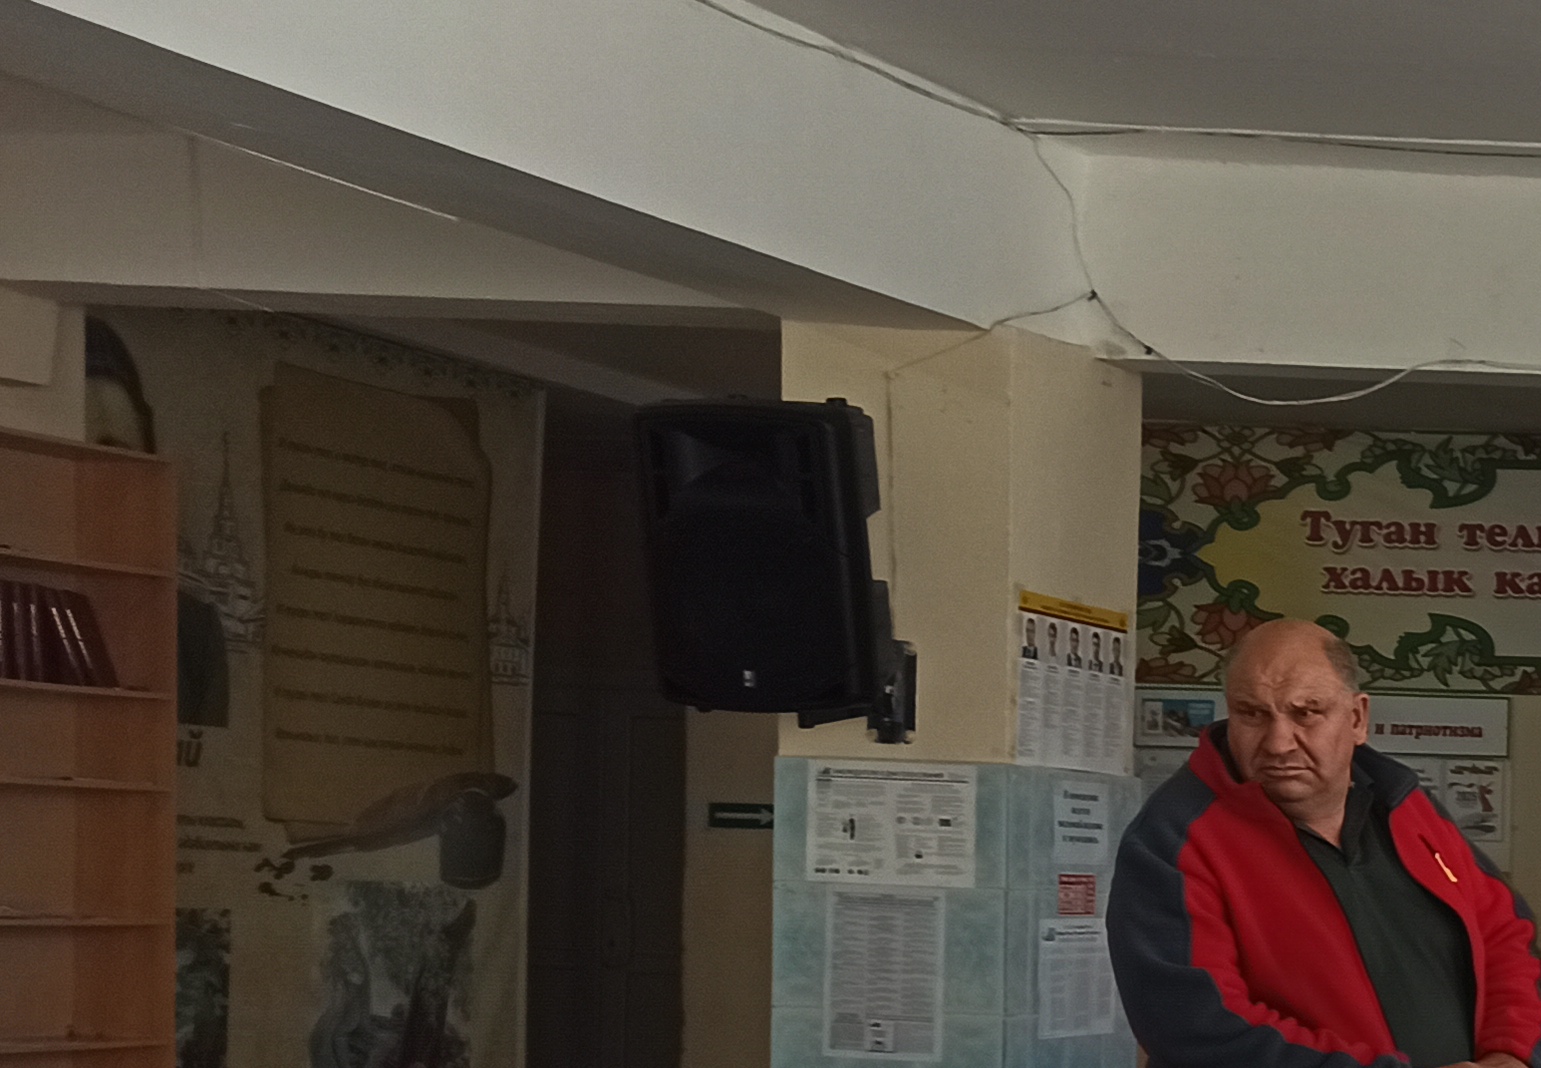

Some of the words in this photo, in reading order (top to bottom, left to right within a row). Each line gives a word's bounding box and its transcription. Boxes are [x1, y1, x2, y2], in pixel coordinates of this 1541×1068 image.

[1301, 510, 1438, 552] Туган
[1321, 566, 1473, 594] халык
[1390, 724, 1483, 739] патриотизма
